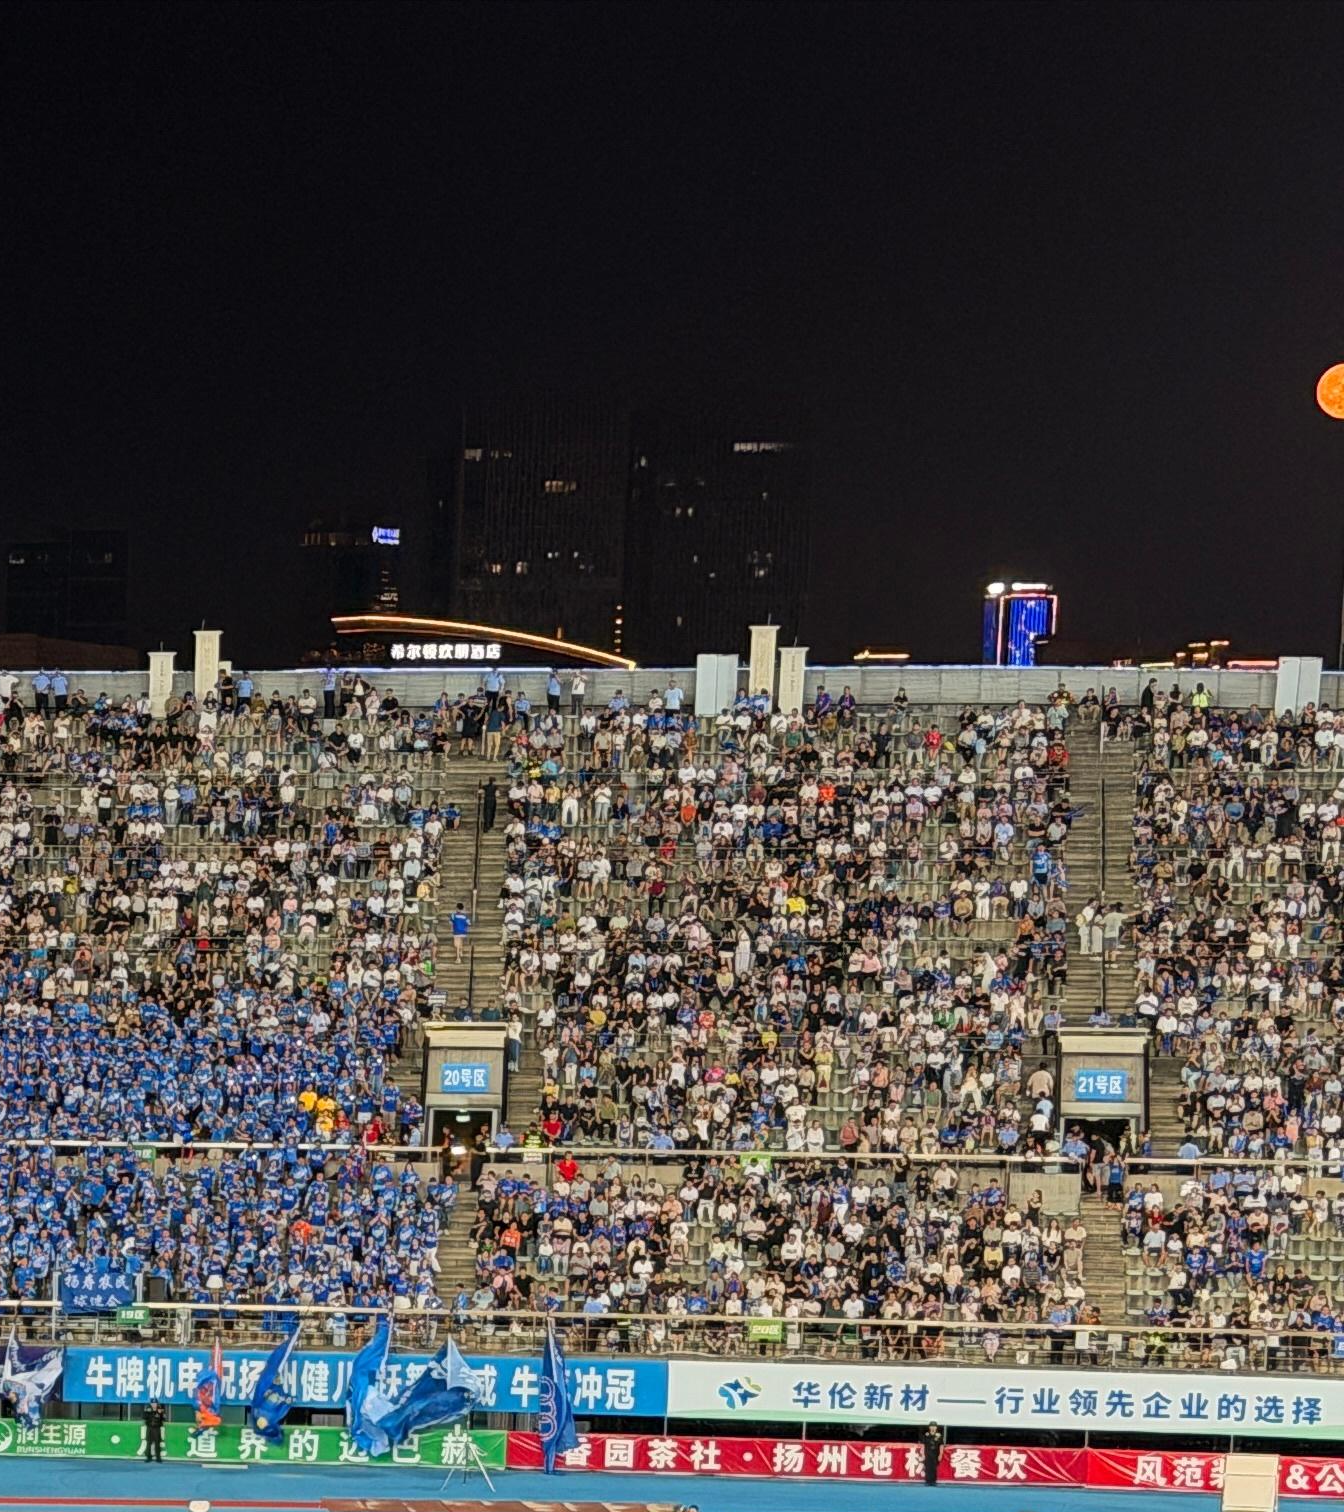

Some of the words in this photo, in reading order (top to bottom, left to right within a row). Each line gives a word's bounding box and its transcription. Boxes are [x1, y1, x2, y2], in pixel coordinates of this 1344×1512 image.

[390, 644, 502, 659] 希尔顿欢朋酒店
[443, 1067, 487, 1087] 20号区
[1077, 1076, 1124, 1096] 21号区
[511, 1365, 635, 1410] 牛冲冠
